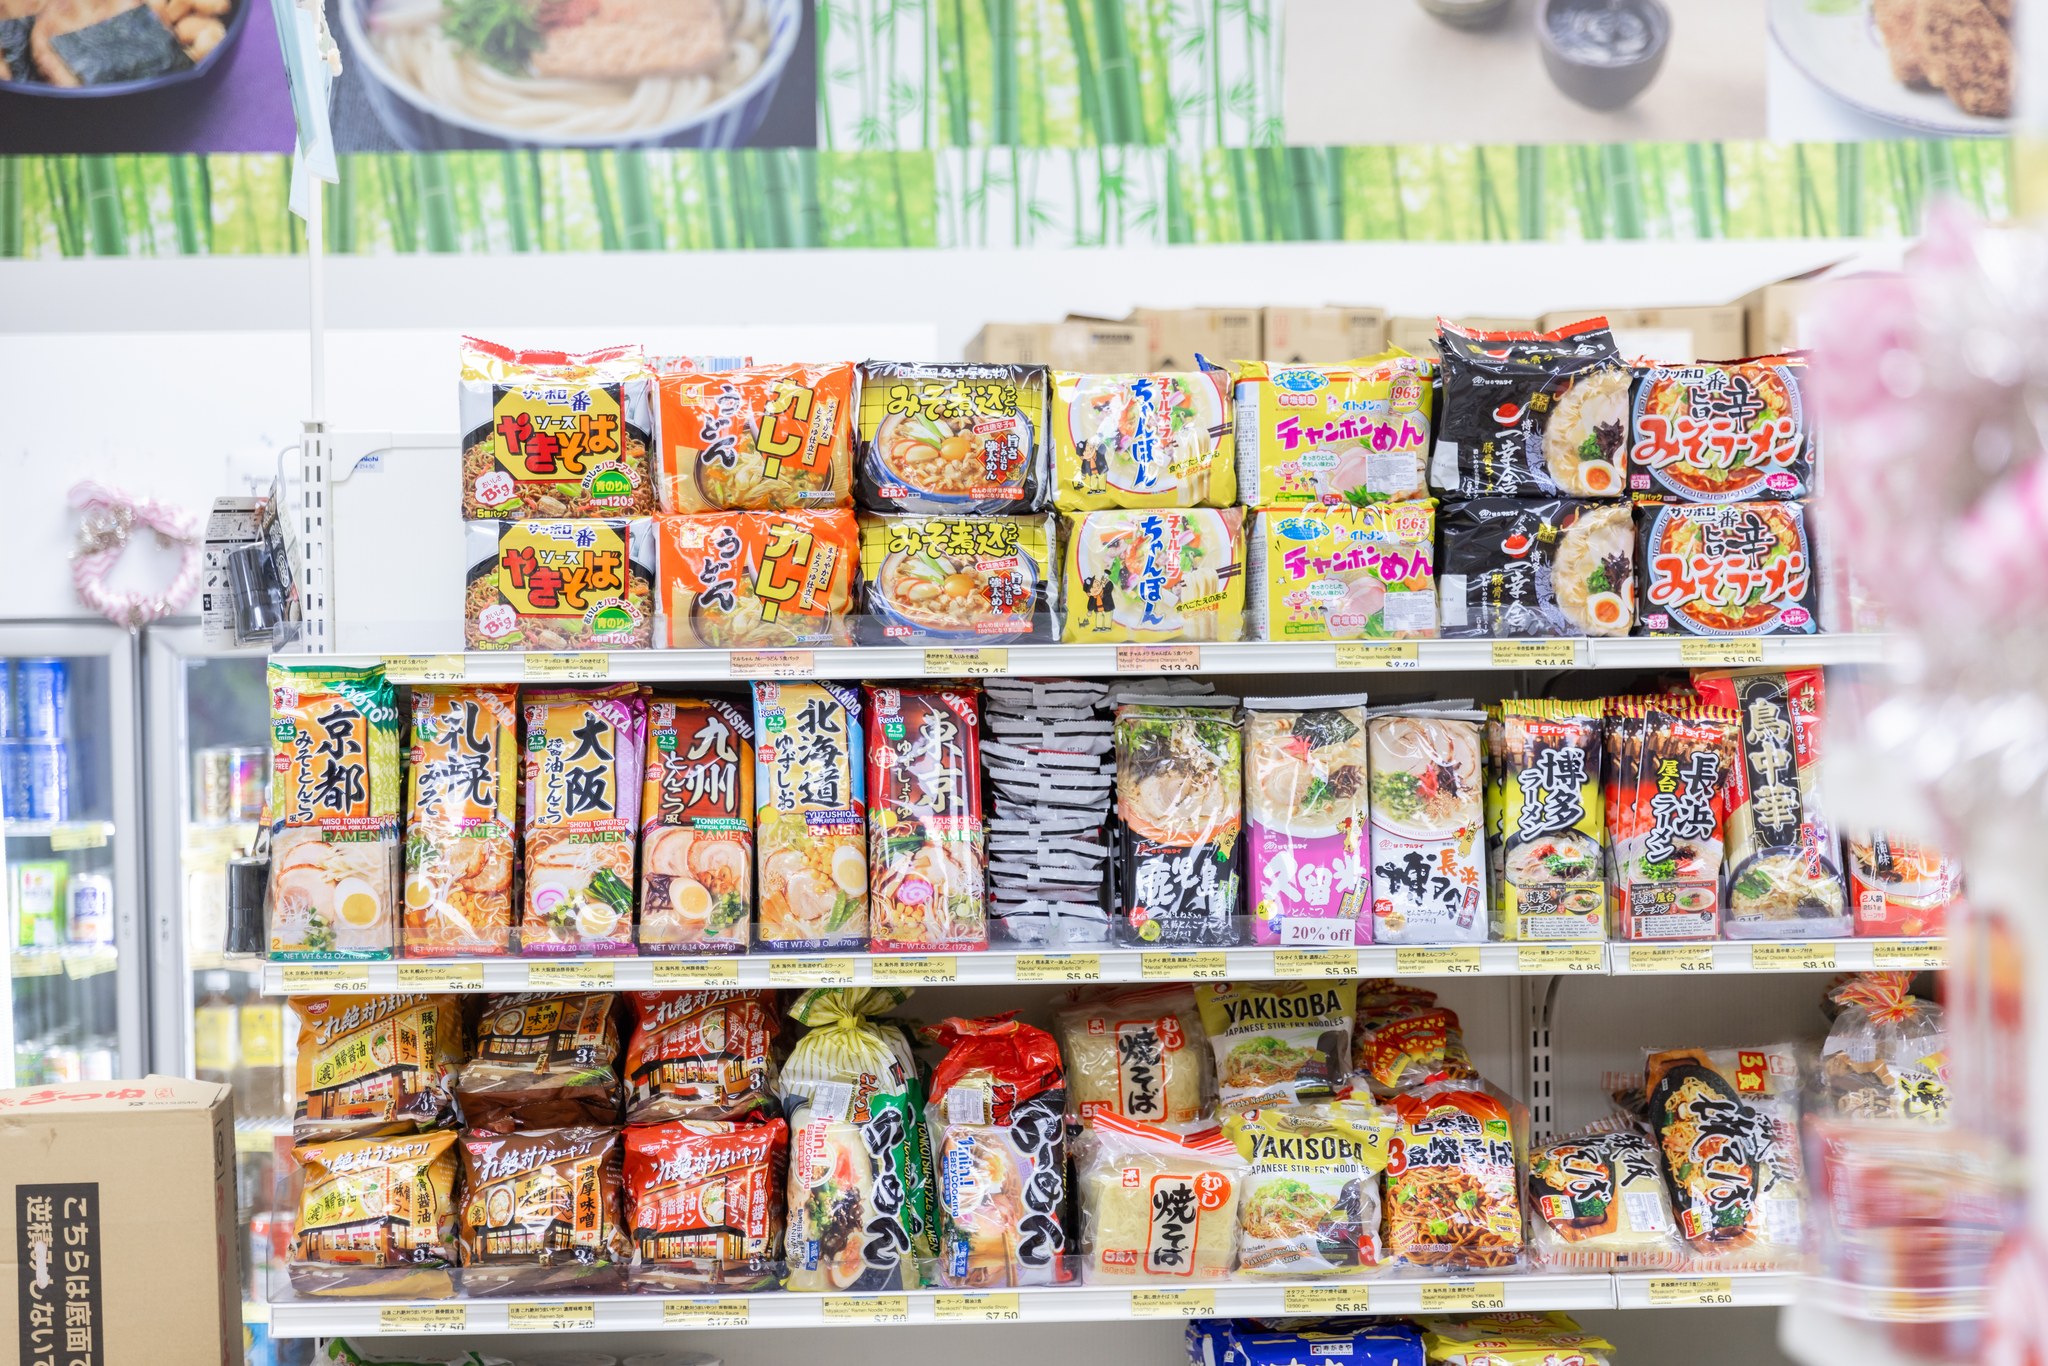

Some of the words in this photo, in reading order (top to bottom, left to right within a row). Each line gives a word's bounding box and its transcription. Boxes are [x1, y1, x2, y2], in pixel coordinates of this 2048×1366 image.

[1657, 369, 1727, 391] サッポロ一番
[1390, 386, 1422, 400] 1963
[1158, 377, 1173, 440] チャルメラ
[1690, 377, 1763, 432] 旨辛
[537, 417, 575, 429] ソース
[701, 386, 741, 468] うどん
[757, 378, 814, 480] カレー
[806, 406, 824, 460] とろつゆ仕立て
[1131, 378, 1158, 488] ちゃんぽん
[497, 412, 619, 473] やきそば
[1277, 416, 1425, 452] チャンポンめん
[1632, 416, 1803, 467] みそラーメン
[1007, 434, 1020, 460] 旨さ
[482, 476, 502, 488] おいしさ
[482, 484, 510, 501] Big
[882, 489, 907, 498] 5食入
[477, 509, 508, 517] 5個パック
[1670, 507, 1739, 528] サッポロ一番
[889, 520, 1005, 558] みそ煮込
[1704, 512, 1774, 569] 旨辛
[540, 551, 580, 564] ソース
[1284, 546, 1433, 581] チャンポンめん
[502, 546, 622, 609] やきそば
[701, 529, 741, 612] うどん
[757, 522, 814, 623] カレー
[1139, 515, 1167, 626] ちゃんぽん
[1648, 552, 1810, 607] みそラーメン
[1010, 572, 1022, 596] 旨さ
[486, 608, 505, 620] おいしさ
[484, 616, 511, 634] Big
[886, 628, 911, 636] 5食入
[1800, 682, 1816, 713] 山形
[759, 708, 786, 717] Ready
[768, 717, 784, 726] 2.5
[277, 726, 294, 735] 2.5
[652, 728, 678, 736] Ready
[887, 724, 903, 732] 2.5
[1540, 725, 1577, 735] ダイショー
[1685, 726, 1720, 741] ダイショー
[529, 737, 544, 745] 2.5
[659, 736, 675, 744] 2.5
[315, 704, 365, 814] 京都
[564, 711, 614, 816] 大阪
[796, 699, 845, 808] 北海道
[915, 709, 964, 814] 東京
[686, 716, 738, 813] 九州
[775, 735, 795, 810] ゆずしお
[1747, 697, 1799, 832] 鳥中華
[1658, 759, 1680, 794] 屋台
[662, 751, 688, 824] とんこつ風
[1538, 746, 1588, 830] 博多
[1675, 753, 1719, 840] 長浜
[1518, 769, 1546, 841] ラーメン
[322, 831, 380, 842] RAMEN
[569, 832, 626, 843] RAMEN
[809, 824, 863, 836] RAMEN
[1646, 794, 1681, 865] ラーメン
[1263, 851, 1367, 906] 久留米
[1437, 849, 1478, 888] 長浜
[1526, 891, 1551, 902] 博多
[1656, 891, 1676, 903] 屋台
[1862, 895, 1882, 903] 2人前
[1292, 908, 1324, 917] とんこつ
[1519, 904, 1557, 915] ラーメン
[1634, 904, 1670, 915] ラーメン
[1292, 926, 1325, 940] 20%
[1331, 929, 1352, 941] off
[1067, 971, 1099, 979] $5.95
[1325, 967, 1357, 975] $5.95
[1803, 961, 1835, 969] $8.10
[334, 982, 367, 991] $6.05
[308, 1002, 327, 1011] NISSIN
[1224, 989, 1341, 1023] YAKISOBA
[528, 1012, 558, 1025] 味噌
[1225, 1023, 1265, 1037] JAPANESE
[1308, 1017, 1344, 1027] NOODLES
[1161, 1016, 1183, 1048] むし
[662, 1040, 701, 1057] ラーメン
[338, 1060, 367, 1081] ラーメン
[1118, 1026, 1161, 1116] 焼そば
[1737, 1052, 1767, 1091] 3食
[1352, 1124, 1380, 1132] SERVINGS
[1250, 1134, 1363, 1161] YAKISOBA
[1368, 1134, 1378, 1147] 2
[580, 1165, 595, 1229] 濃厚味噌
[1201, 1173, 1224, 1208] むし
[660, 1214, 696, 1230] ラーメン
[1153, 1182, 1196, 1268] 焼そば
[1104, 1250, 1135, 1264] 5食入
[1335, 1304, 1368, 1312] $5.85
[1471, 1301, 1503, 1309] $6.90
[1700, 1295, 1732, 1303] $6.60
